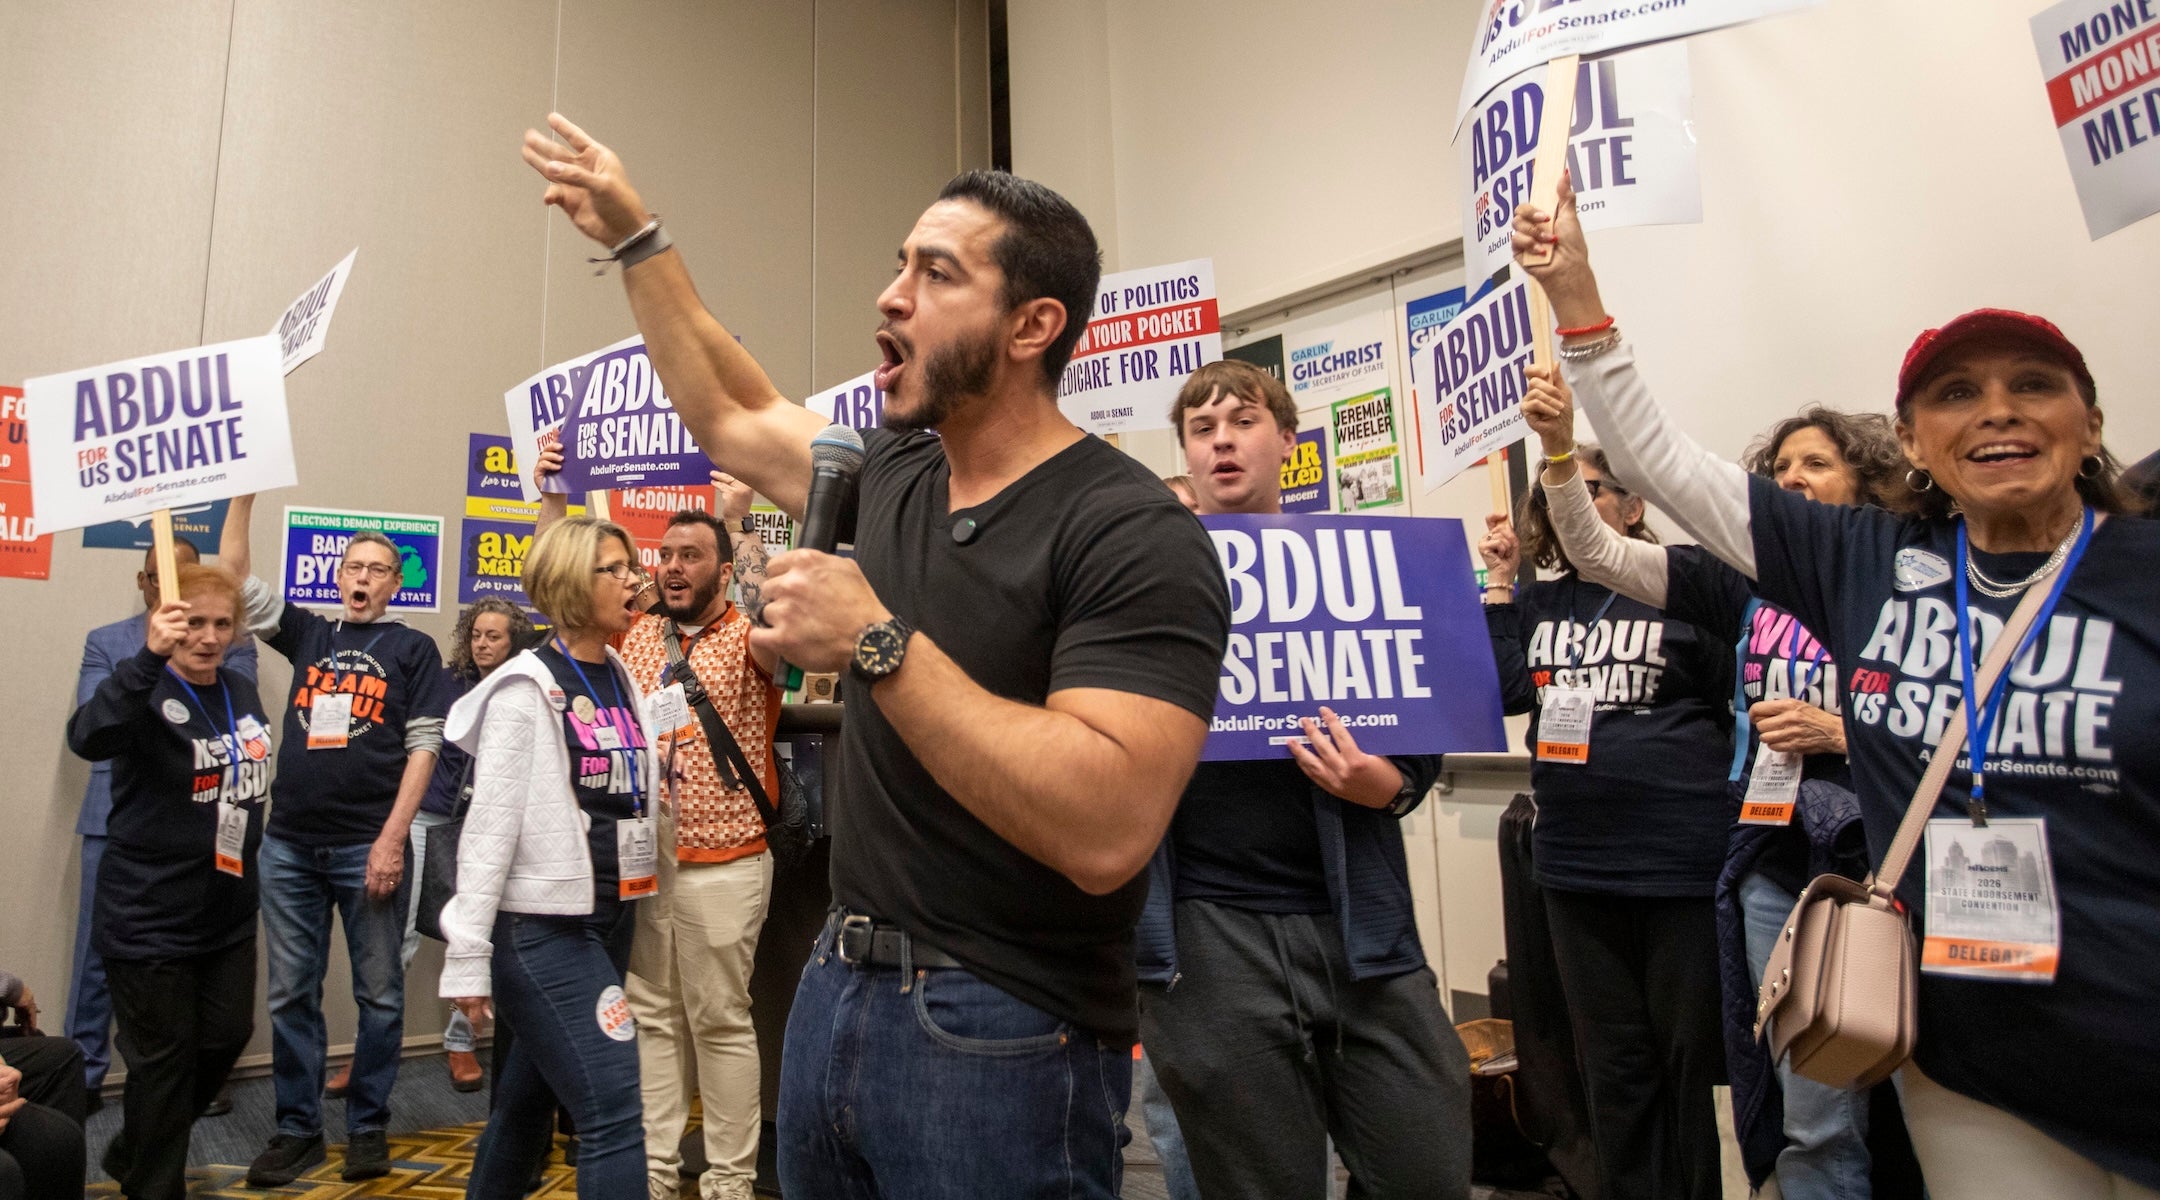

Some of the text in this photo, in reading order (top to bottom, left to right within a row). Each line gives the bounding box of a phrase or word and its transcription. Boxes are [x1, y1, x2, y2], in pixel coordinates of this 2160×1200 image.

[1489, 0, 1686, 67] AbdulForSenate.com
[2059, 0, 2157, 64] MONE
[2069, 30, 2160, 109] MONE
[1475, 191, 1489, 222] FOR
[1477, 208, 1491, 242] US
[279, 271, 336, 339] ABDUL
[1101, 275, 1200, 314] OF POLITICS
[1092, 319, 1132, 349] YOUR
[1137, 307, 1202, 340] POCKET
[1411, 307, 1454, 327] GARLIN
[1291, 343, 1329, 362] GARLIN
[1292, 342, 1383, 381] GILCHRIST
[1119, 349, 1160, 385] FOR
[1294, 383, 1309, 391] FOR
[1312, 371, 1350, 387] SECRETARY
[1352, 367, 1362, 377] OF
[1363, 362, 1384, 374] STATE
[74, 353, 243, 442] ABDUL
[1456, 350, 1534, 434] SENAT
[1111, 407, 1134, 418] SENATE
[1333, 396, 1392, 427] JEREMIAH
[1439, 403, 1454, 427] FOR
[577, 422, 598, 442] FOR
[1336, 416, 1392, 444] WHEELER
[1442, 418, 1456, 446] US
[1454, 412, 1524, 457] AbdulForSenate.co
[78, 446, 108, 469] FOR
[114, 415, 247, 483] SENATE
[577, 440, 598, 460] US
[1369, 445, 1397, 458] STATE
[80, 462, 110, 488] US
[480, 475, 499, 488] for
[501, 479, 509, 488] U
[590, 462, 680, 476] AbdulForSenate.com
[104, 472, 227, 504] AbdulForSenate.com
[622, 488, 706, 514] McDONALD
[173, 525, 210, 533] SENATE
[290, 514, 438, 534] ELECTIONS DEMAND EXPERIENCE
[473, 579, 492, 592] for
[494, 582, 502, 591] U
[513, 582, 523, 592] M
[1208, 528, 1423, 625] BDUL
[289, 587, 312, 598] FOR
[401, 592, 432, 603] STATE
[1527, 619, 1667, 668] ABDUL
[352, 649, 362, 657] OF
[362, 653, 387, 678] POLITICS
[1219, 628, 1432, 705] SENATE
[306, 665, 388, 700] TEAM
[1850, 667, 1891, 693] FOR
[348, 722, 373, 739] OCKET
[1547, 745, 1579, 756] DELEGATE
[581, 757, 609, 776] FOR
[1918, 749, 2119, 780] AulorSenate.com
[193, 774, 220, 793] FOR
[1749, 805, 1785, 817] DELEGATE
[1941, 887, 2039, 902] STATE ENDORSEMENT
[1977, 879, 2001, 887] 2026
[1961, 900, 2019, 912] CONVENTION
